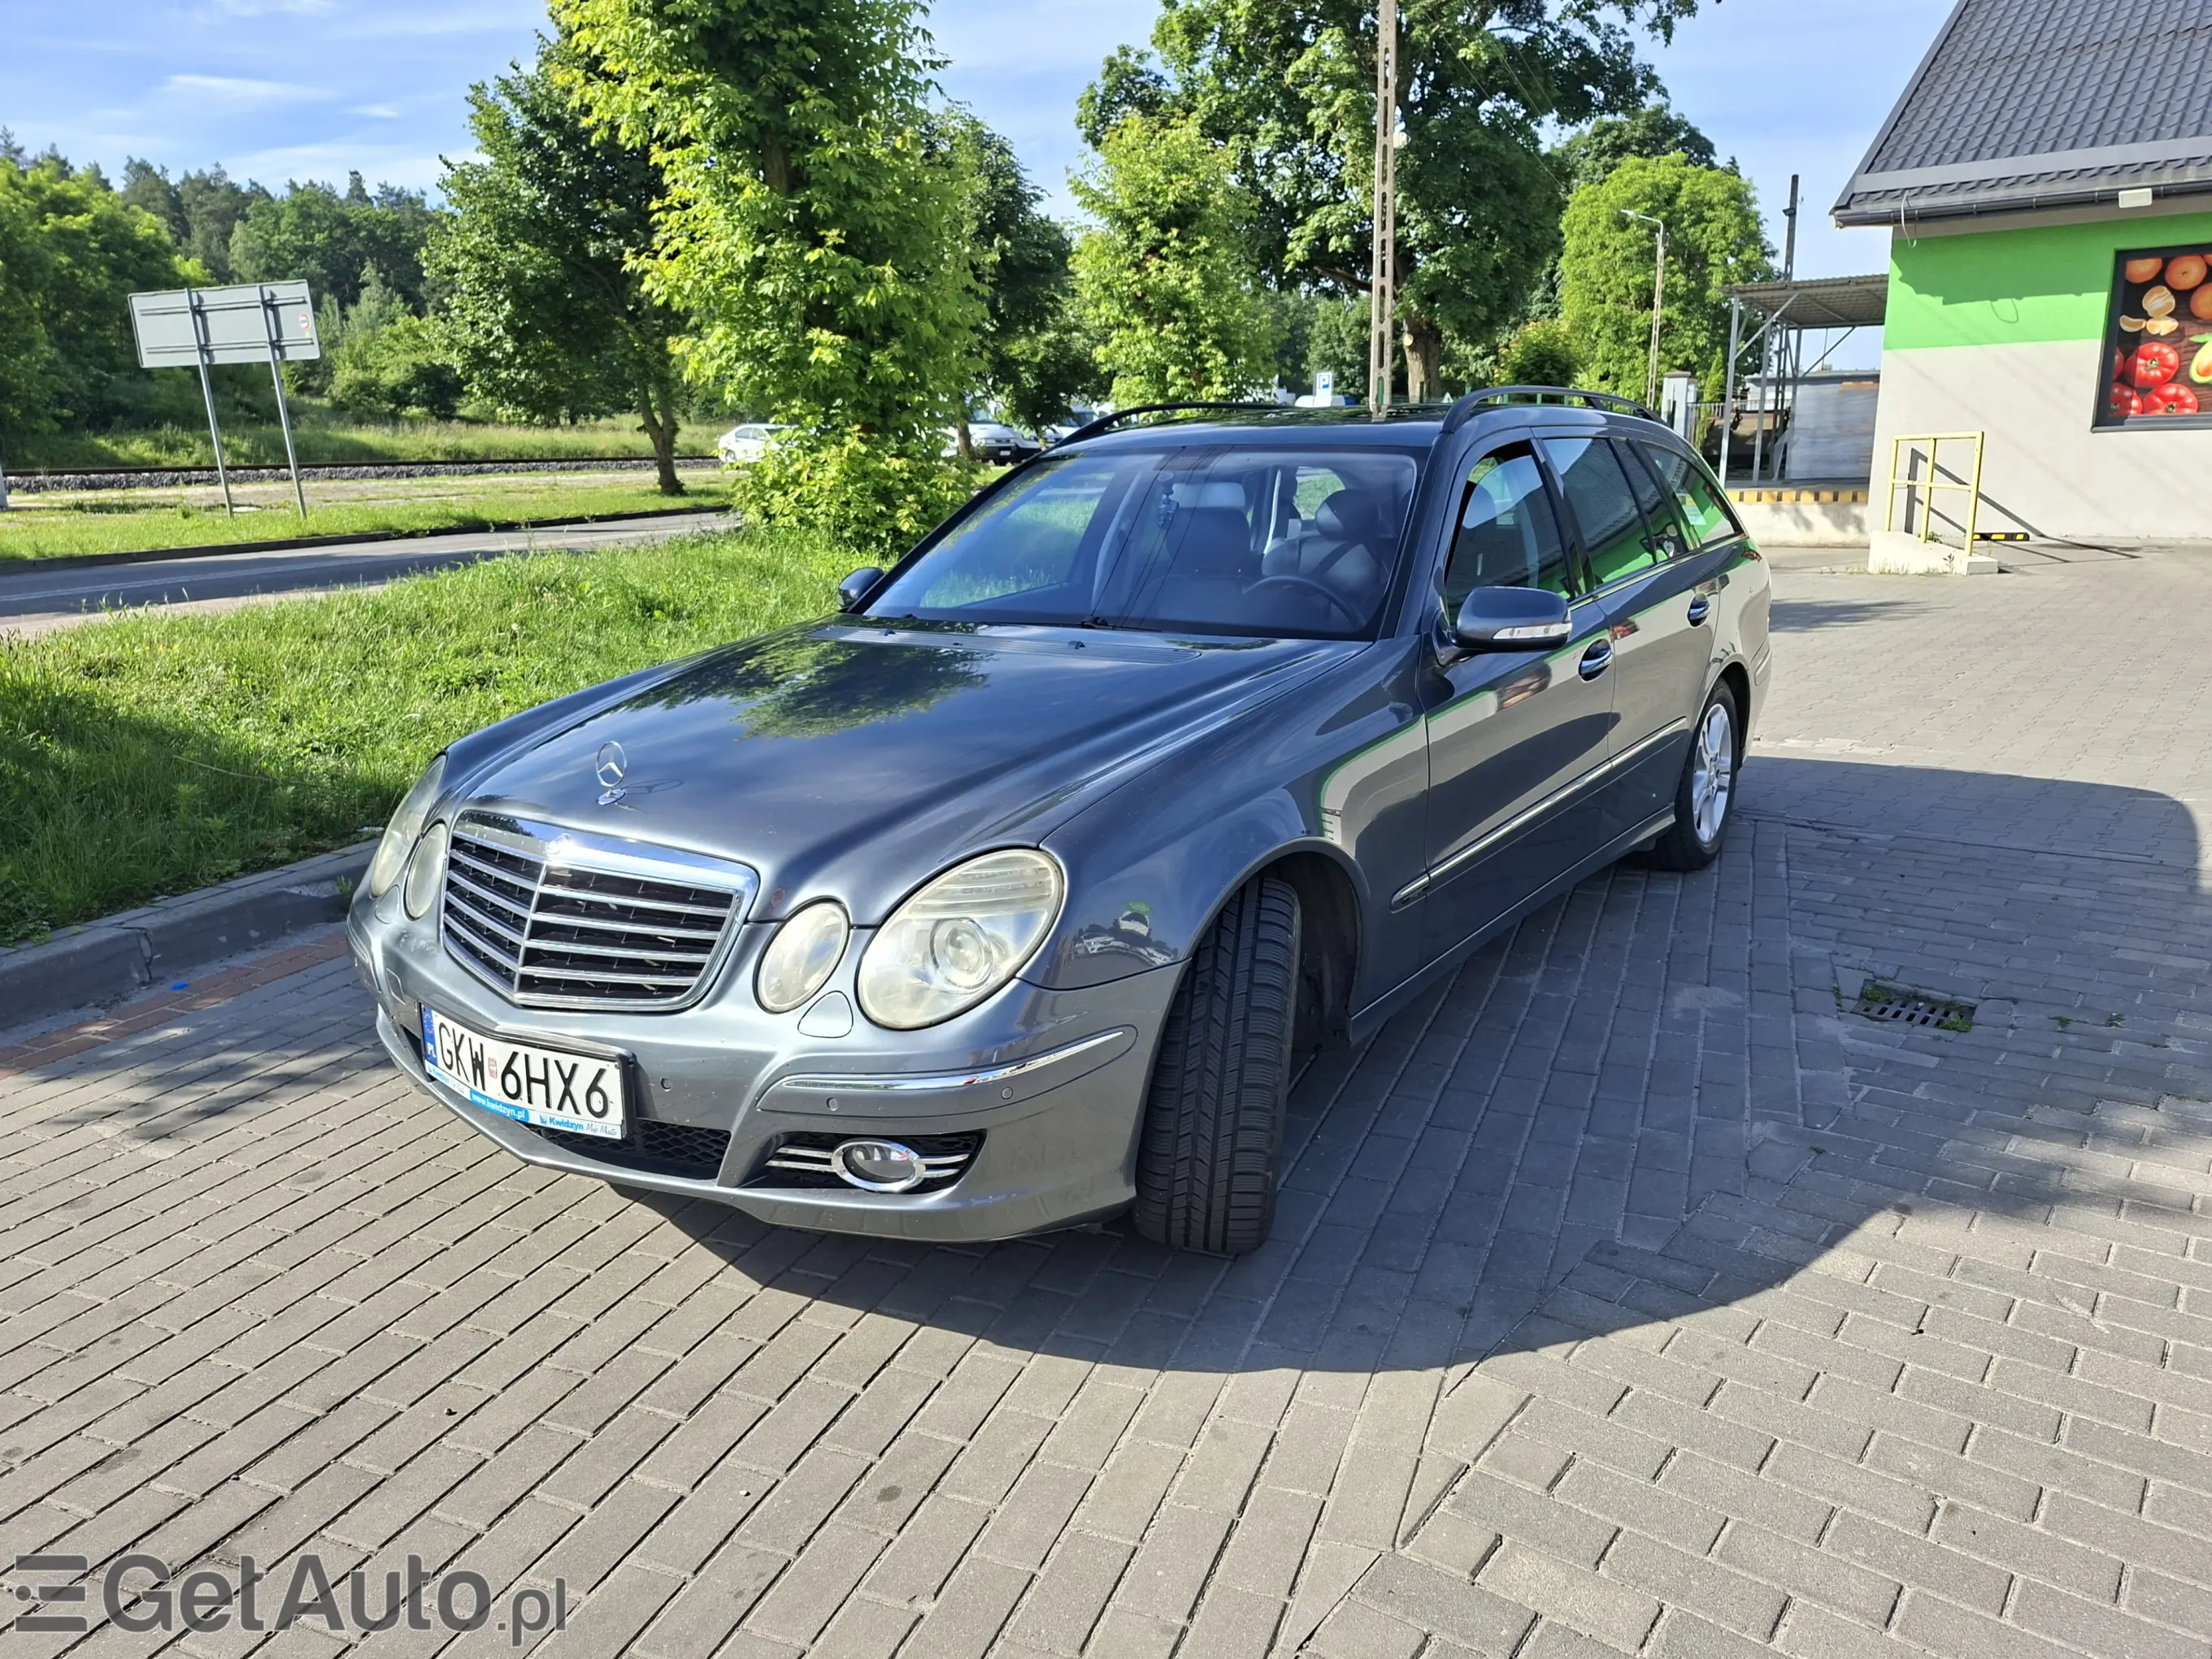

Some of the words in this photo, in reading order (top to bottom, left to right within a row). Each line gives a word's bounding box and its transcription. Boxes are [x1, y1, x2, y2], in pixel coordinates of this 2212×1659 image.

[1319, 376, 1329, 389] P
[427, 1042, 437, 1058] PL
[438, 1022, 486, 1092] GKW
[501, 1051, 609, 1118] 6HX6
[472, 1092, 526, 1119] www.kwidzyn.pl
[549, 1116, 584, 1131] Kwidzyn
